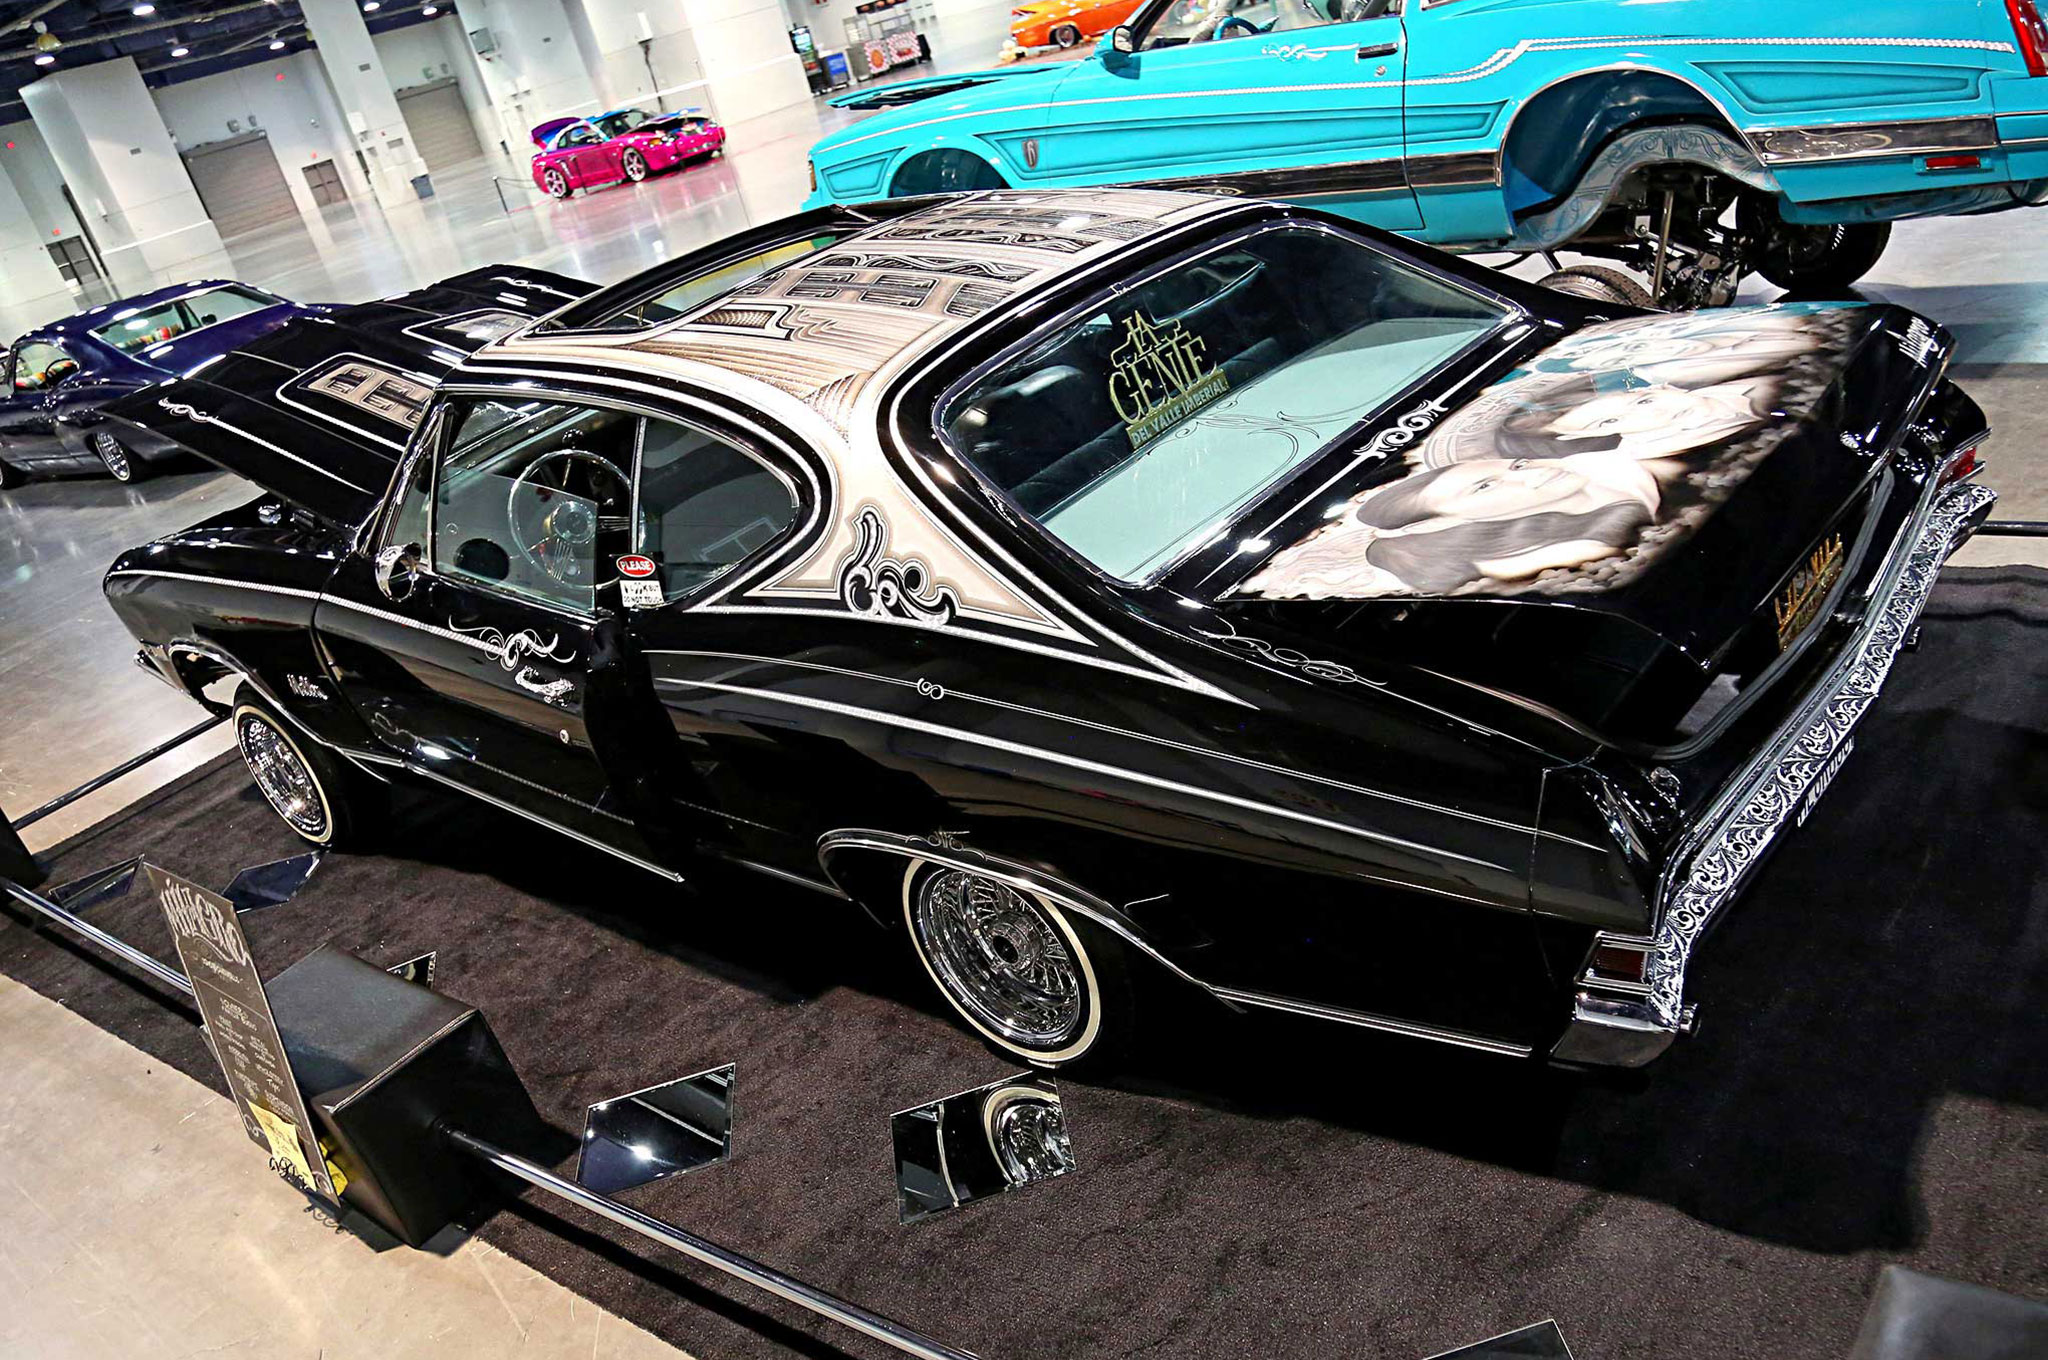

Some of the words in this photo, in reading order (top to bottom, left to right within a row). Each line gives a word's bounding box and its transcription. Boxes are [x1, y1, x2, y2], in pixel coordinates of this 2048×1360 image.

[1122, 310, 1161, 357] LA
[1109, 331, 1217, 425] GENTE
[1131, 426, 1152, 445] DEL
[1151, 405, 1182, 431] VALLE
[1181, 378, 1228, 414] IMPERIAL
[619, 560, 652, 571] PLEASE
